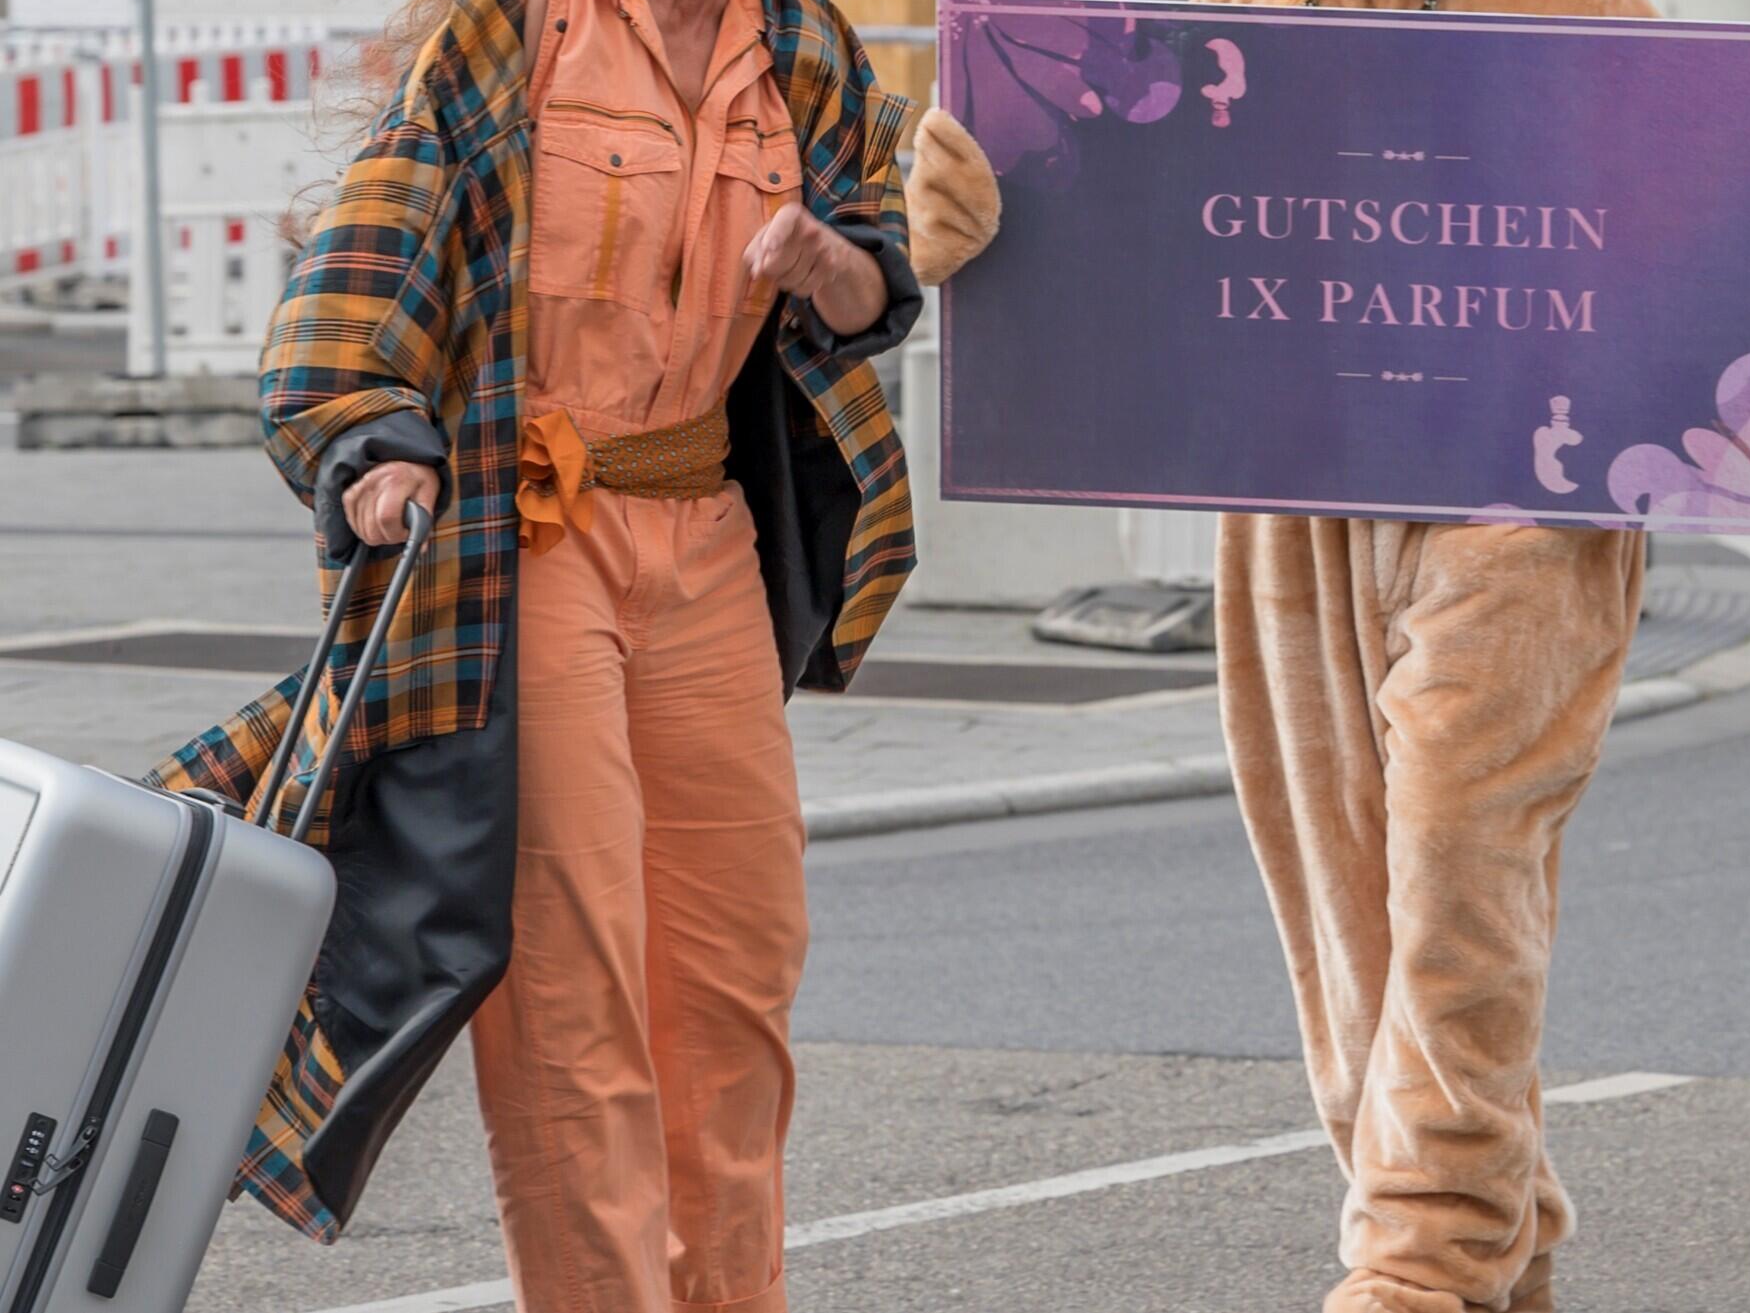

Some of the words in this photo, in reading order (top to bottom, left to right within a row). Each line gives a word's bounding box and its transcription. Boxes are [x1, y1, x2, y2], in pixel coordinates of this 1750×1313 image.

[1201, 193, 1609, 251] GUTSCHEIN
[1216, 276, 1291, 321] 1X
[1318, 279, 1599, 333] PARFUM
